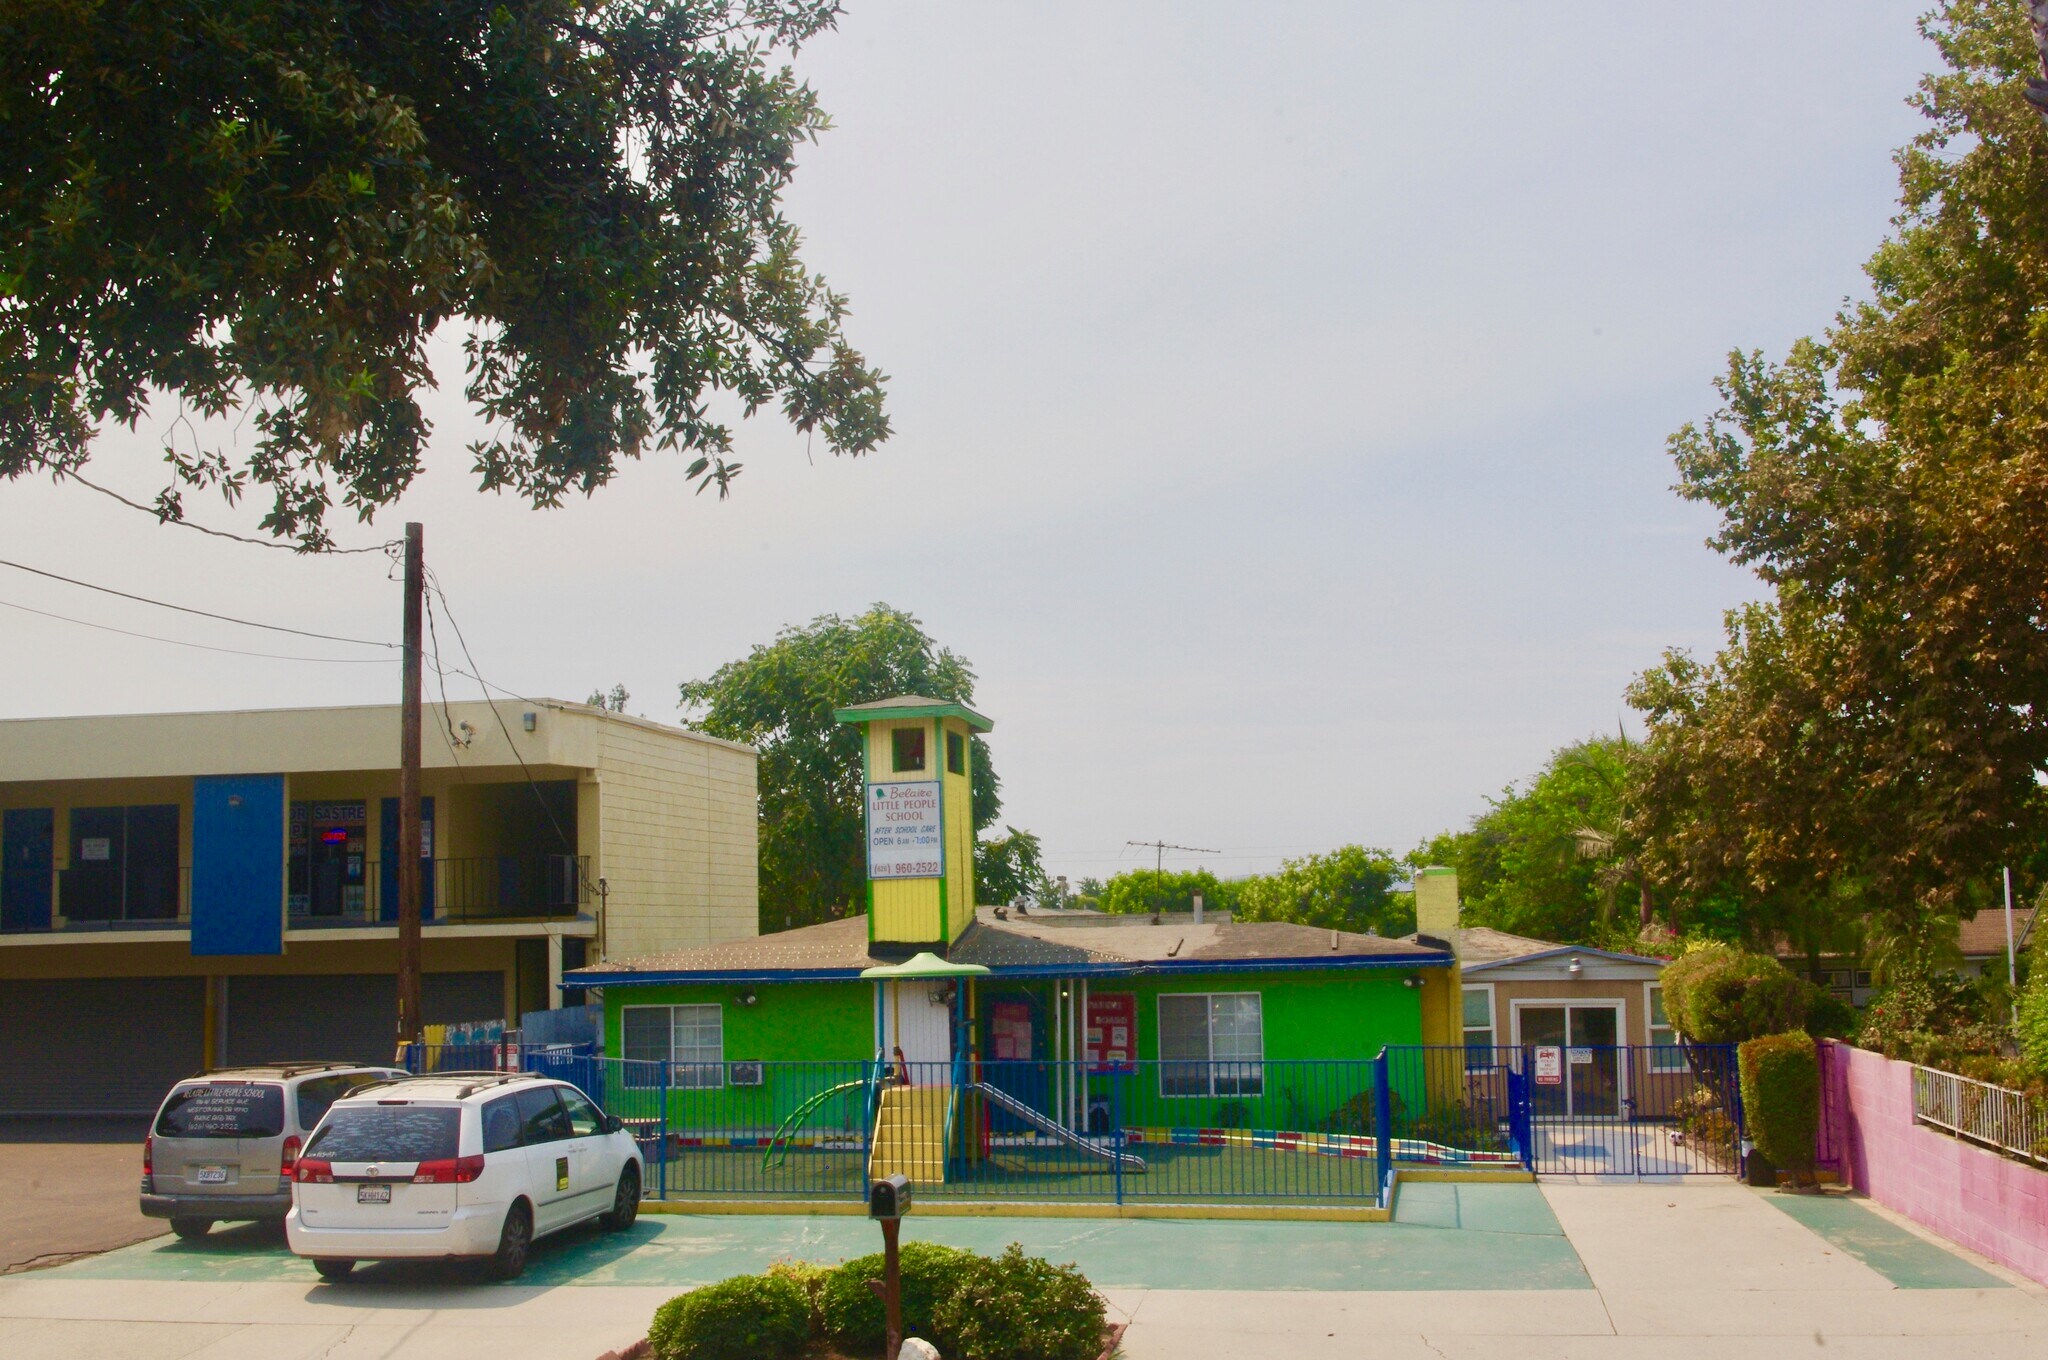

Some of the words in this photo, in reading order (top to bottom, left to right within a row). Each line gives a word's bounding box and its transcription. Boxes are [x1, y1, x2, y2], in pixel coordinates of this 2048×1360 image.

[890, 787, 933, 799] Belaire
[872, 801, 900, 811] LITTLE
[904, 799, 937, 809] PEOPLE
[314, 805, 366, 820] SASTRE
[885, 811, 924, 822] SCHOOL
[874, 826, 892, 834] AFTER
[895, 826, 918, 834] SCHOOL
[921, 825, 937, 833] CARE
[873, 837, 894, 846] OPEN
[895, 861, 938, 874] 960-2522
[242, 1087, 266, 1099] SCHOOL
